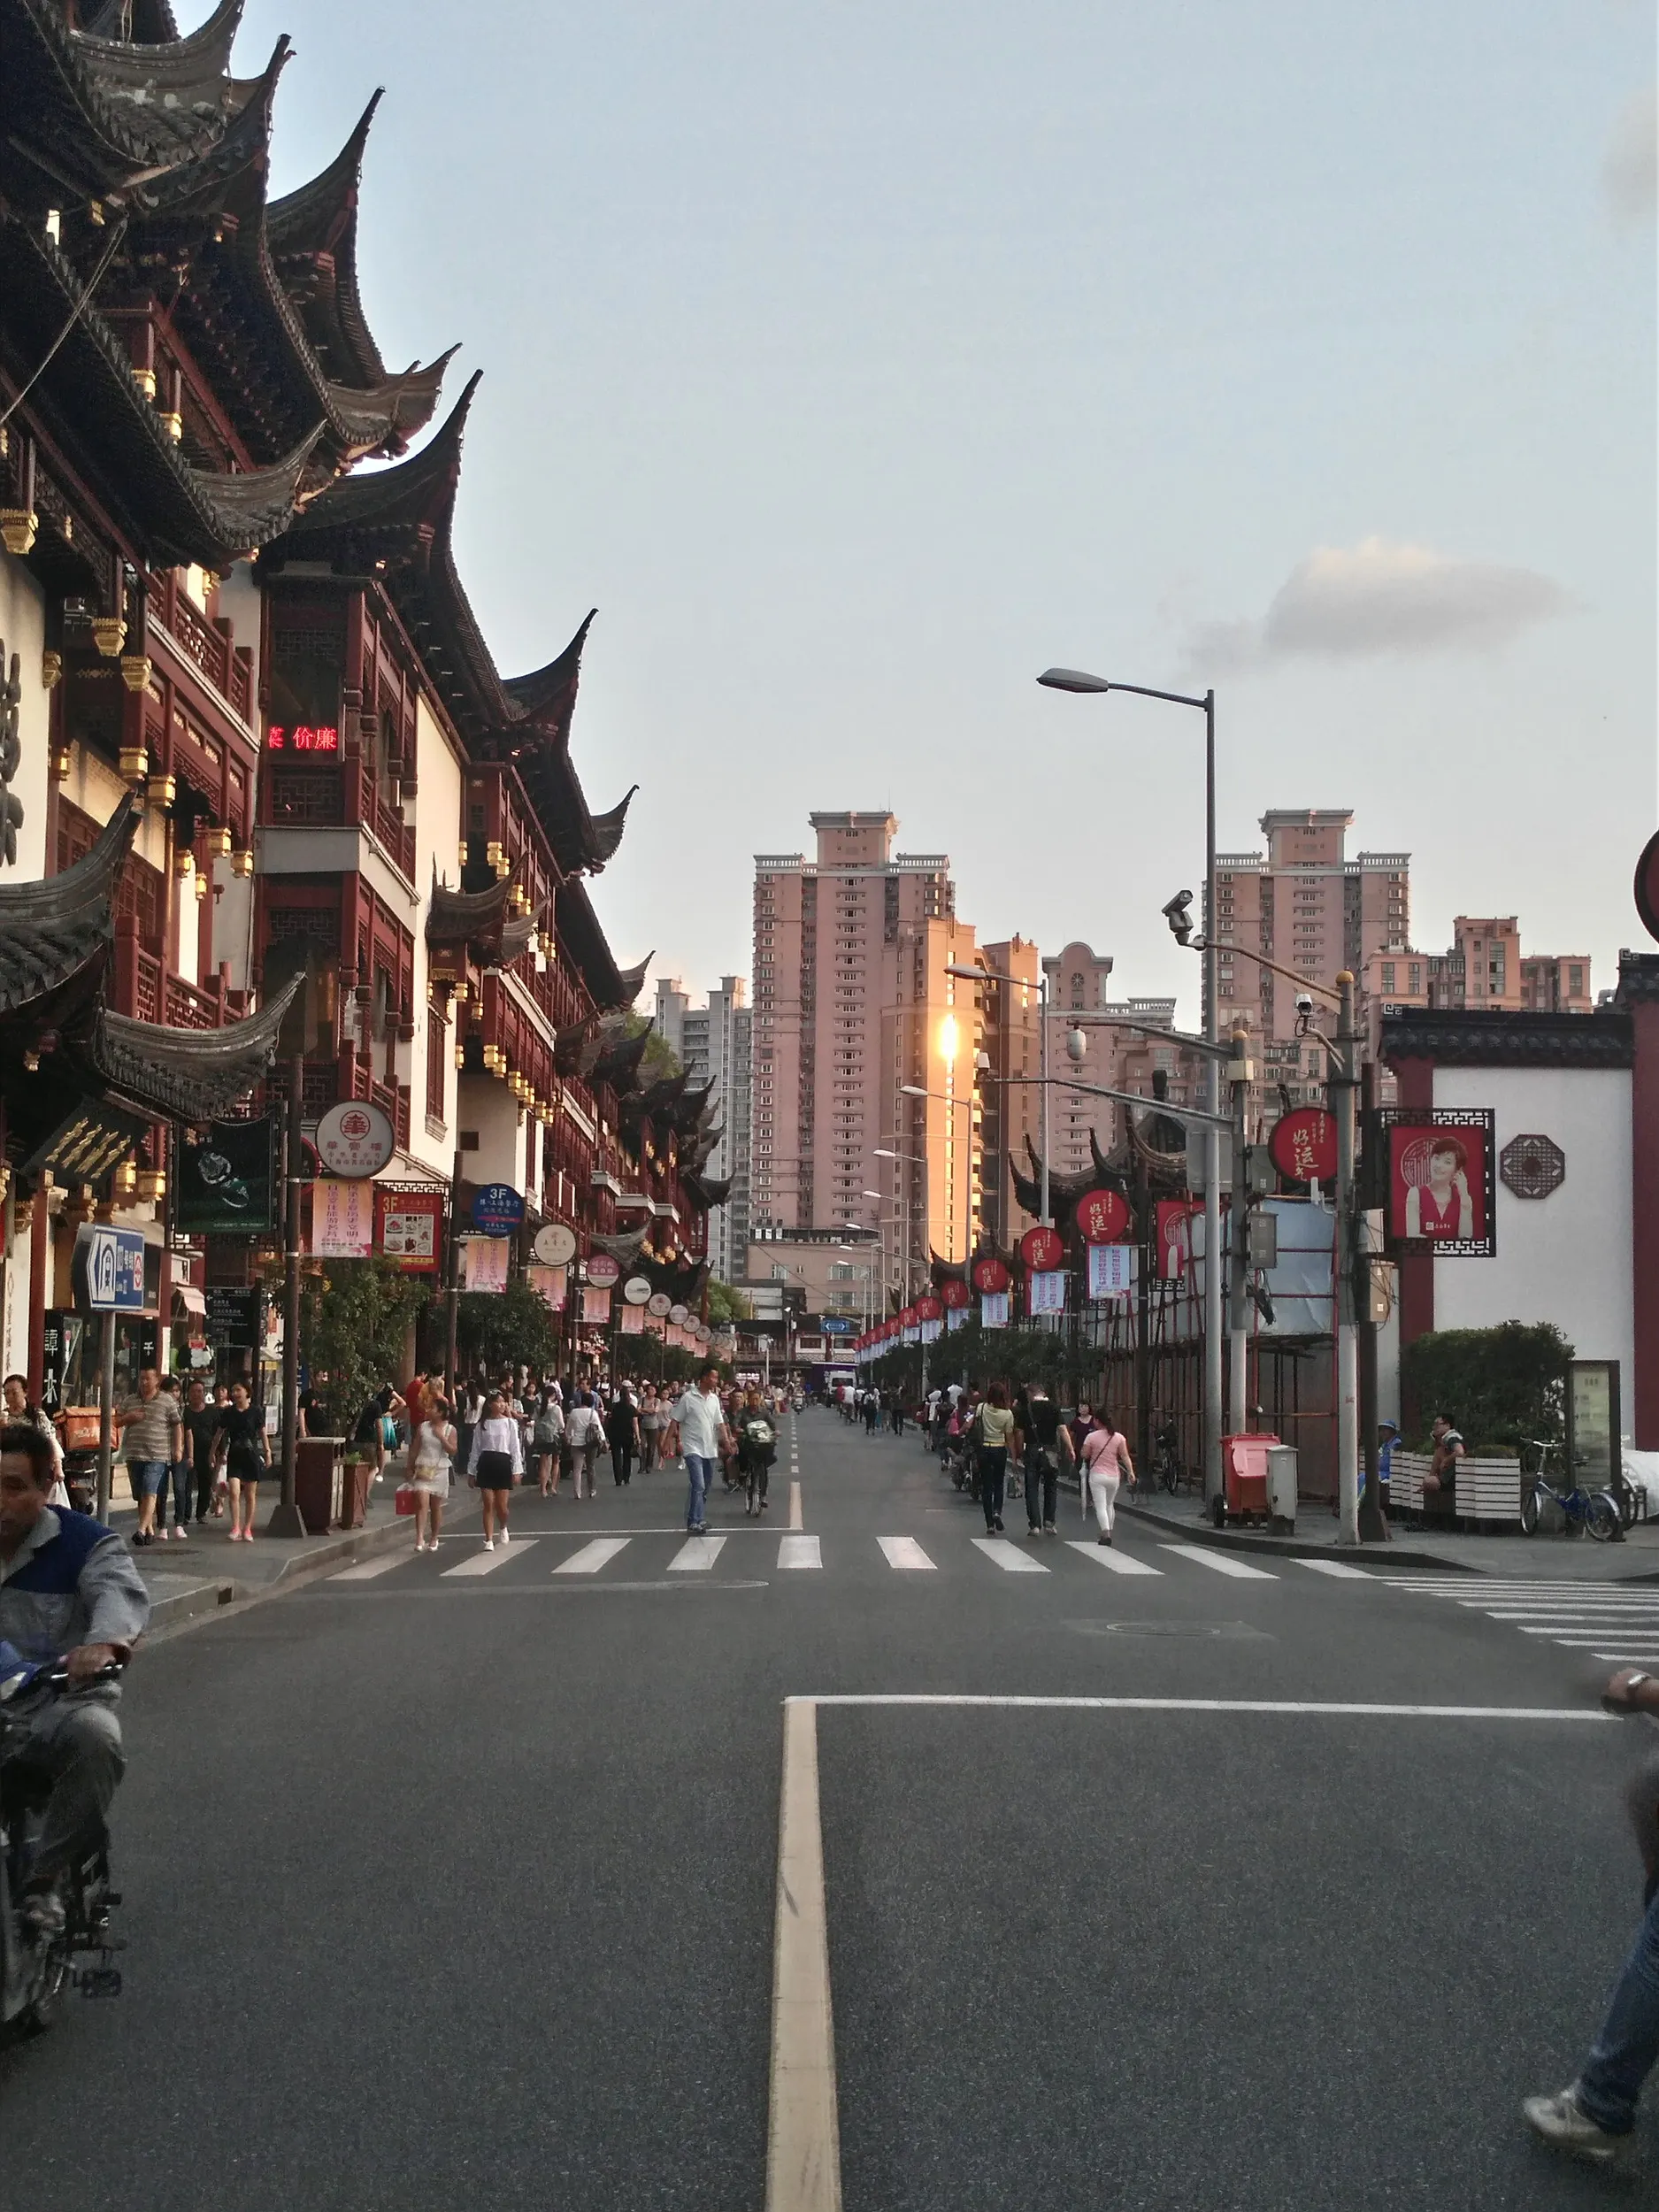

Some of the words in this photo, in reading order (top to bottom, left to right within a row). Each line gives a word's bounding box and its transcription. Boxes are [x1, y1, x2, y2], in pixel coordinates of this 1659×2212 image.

[293, 726, 336, 749] 价廉
[489, 1188, 507, 1199] 3F
[383, 1197, 397, 1212] 3F
